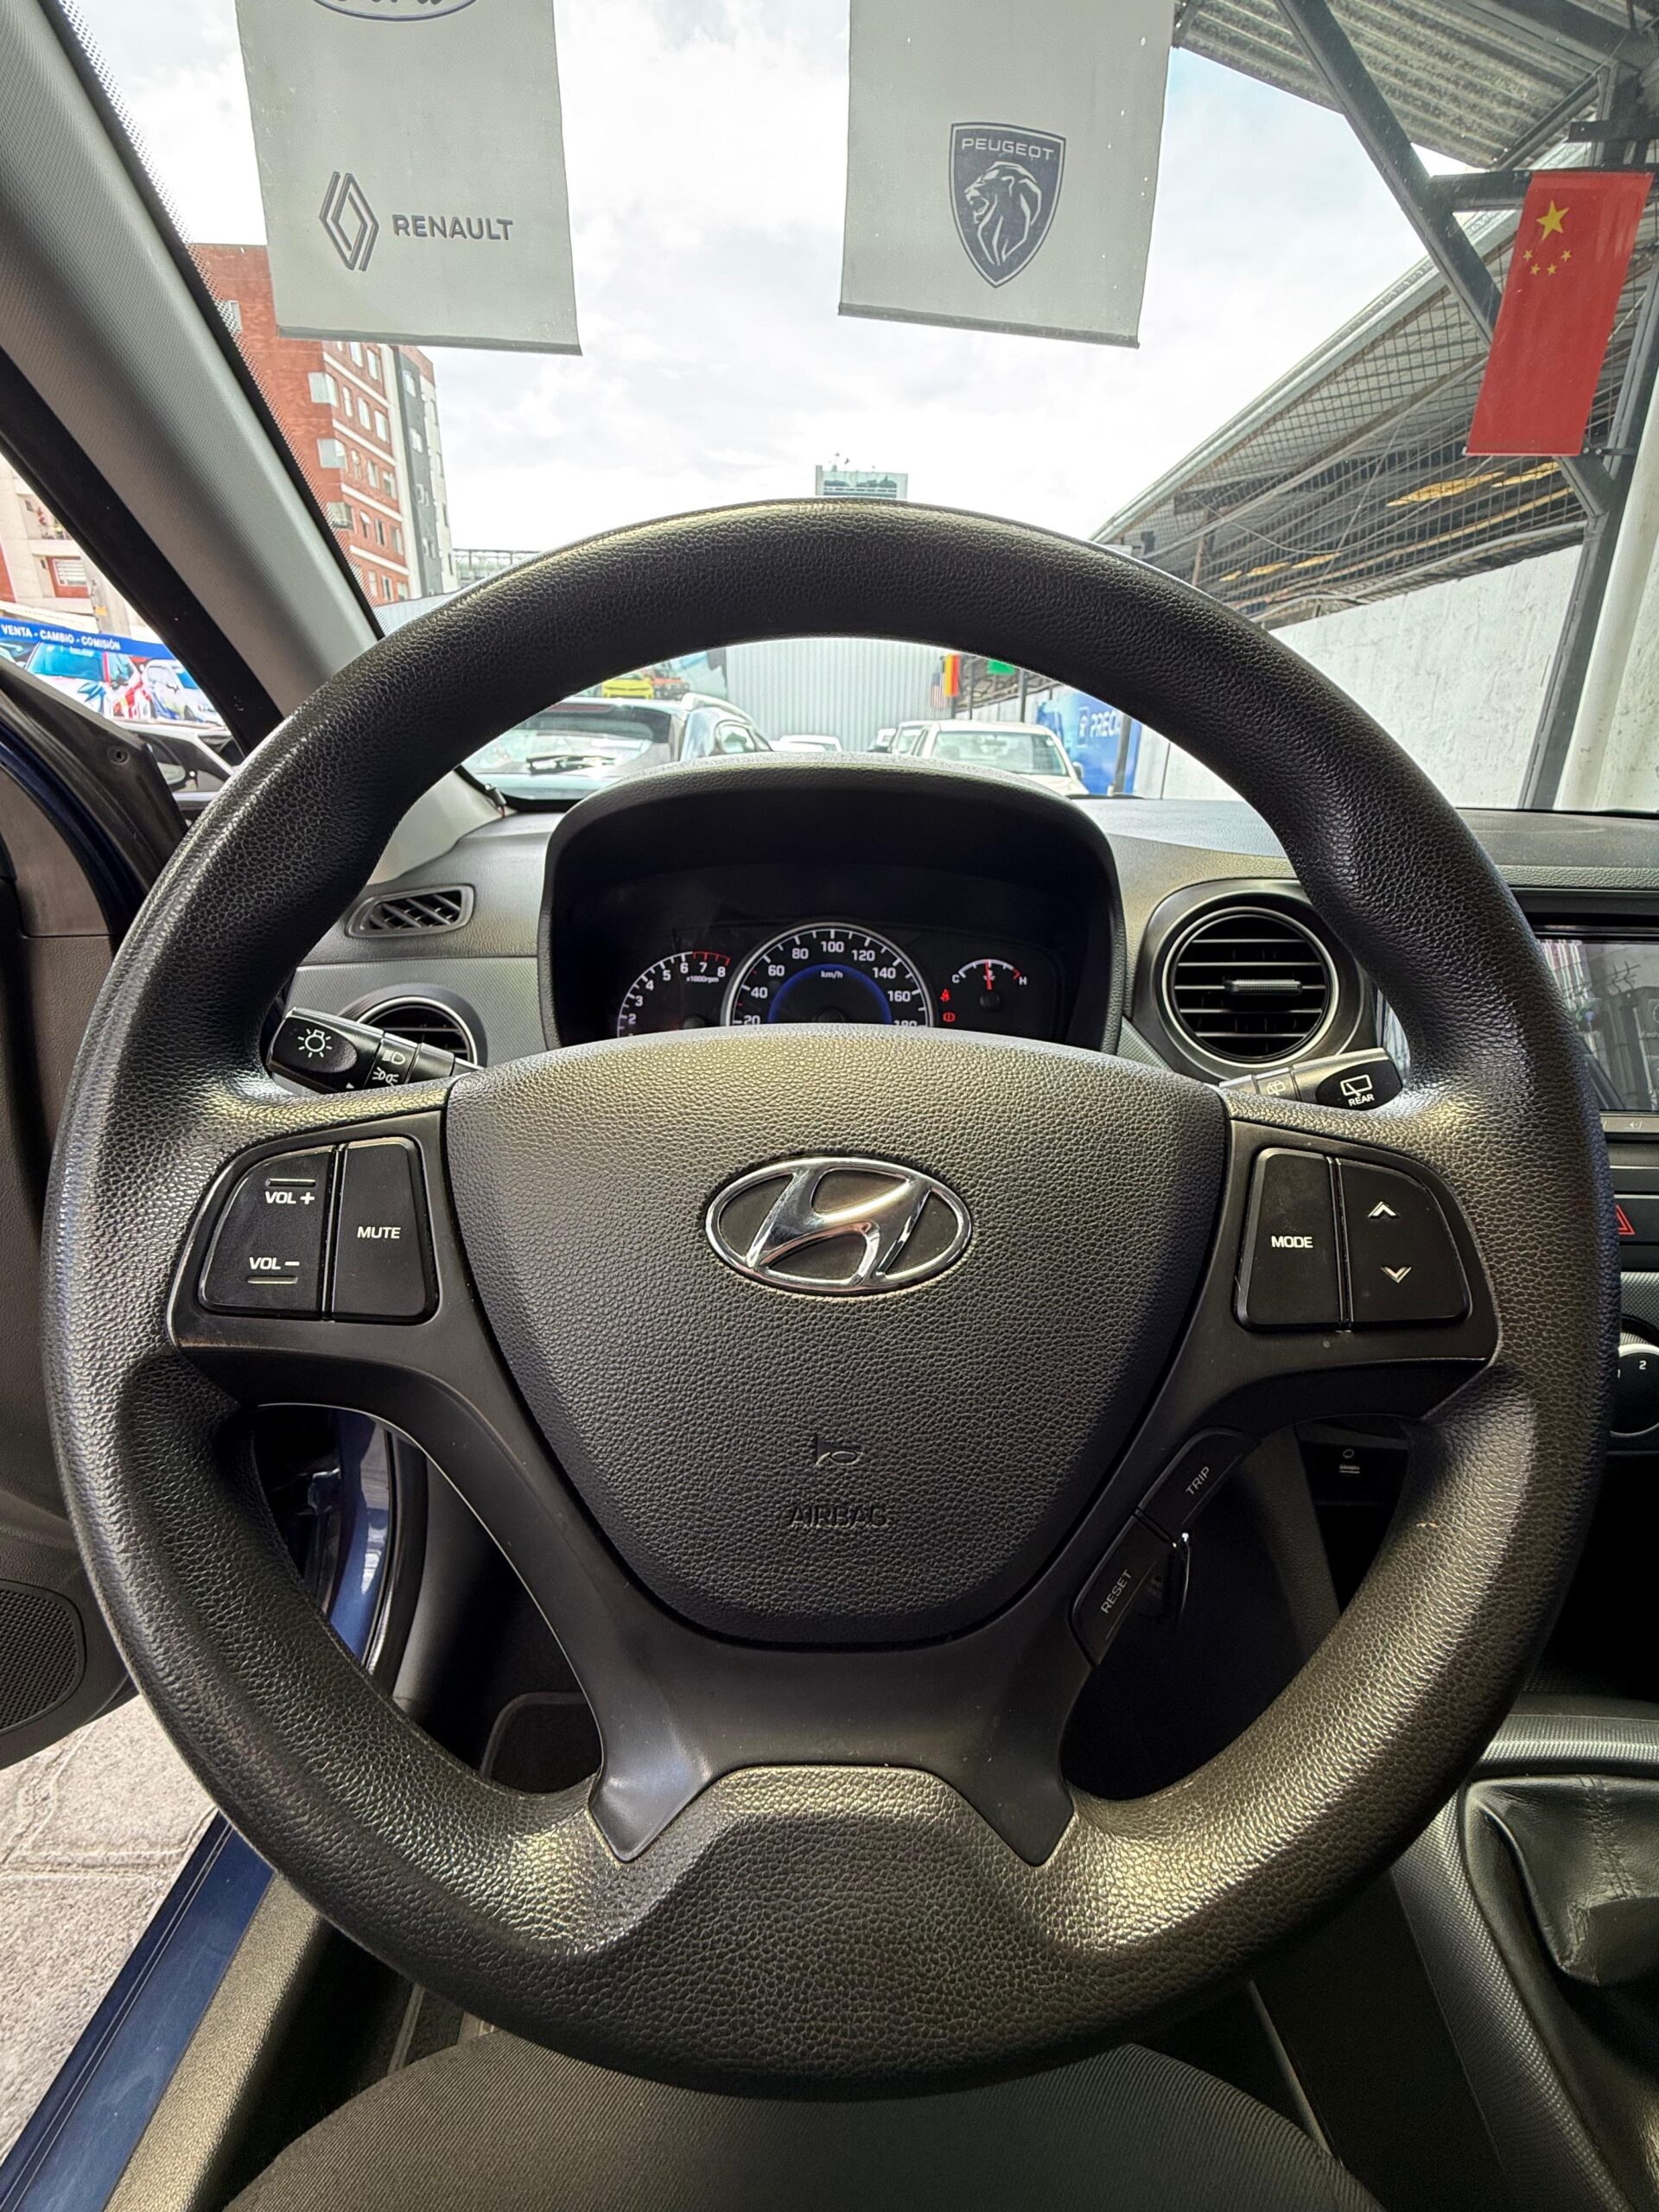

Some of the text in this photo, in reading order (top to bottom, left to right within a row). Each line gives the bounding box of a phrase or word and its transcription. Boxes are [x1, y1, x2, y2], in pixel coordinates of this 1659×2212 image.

[961, 137, 1054, 161] PEUGEOT
[391, 213, 514, 240] RENAULT
[1, 624, 33, 639] VENTA
[40, 629, 75, 645] CAMBIO
[81, 635, 121, 651] COMISIÓN
[821, 940, 844, 953] 100
[791, 948, 809, 960] 80
[852, 950, 875, 962] 120
[680, 963, 689, 974] 6
[699, 962, 708, 973] 7
[717, 966, 726, 977] 8
[767, 964, 785, 976] 60
[872, 967, 896, 979] 140
[663, 969, 671, 981] 5
[821, 970, 843, 979] km/h
[951, 974, 960, 983] C
[1019, 976, 1027, 985] H
[645, 980, 654, 990] 4
[750, 987, 768, 999] 40
[887, 990, 912, 1002] 160
[635, 995, 643, 1007] 3
[628, 1014, 636, 1025] 2
[743, 1014, 760, 1025] 20
[1348, 1094, 1375, 1107] REAR
[264, 1191, 296, 1205] VOL
[357, 1226, 402, 1239] MUTE
[1270, 1236, 1313, 1249] MODE
[249, 1256, 281, 1270] VOL
[1638, 1360, 1647, 1370] 2
[1185, 1466, 1210, 1496] TRIP
[789, 1503, 890, 1529] AIRBAG
[1100, 1569, 1132, 1614] RESET
